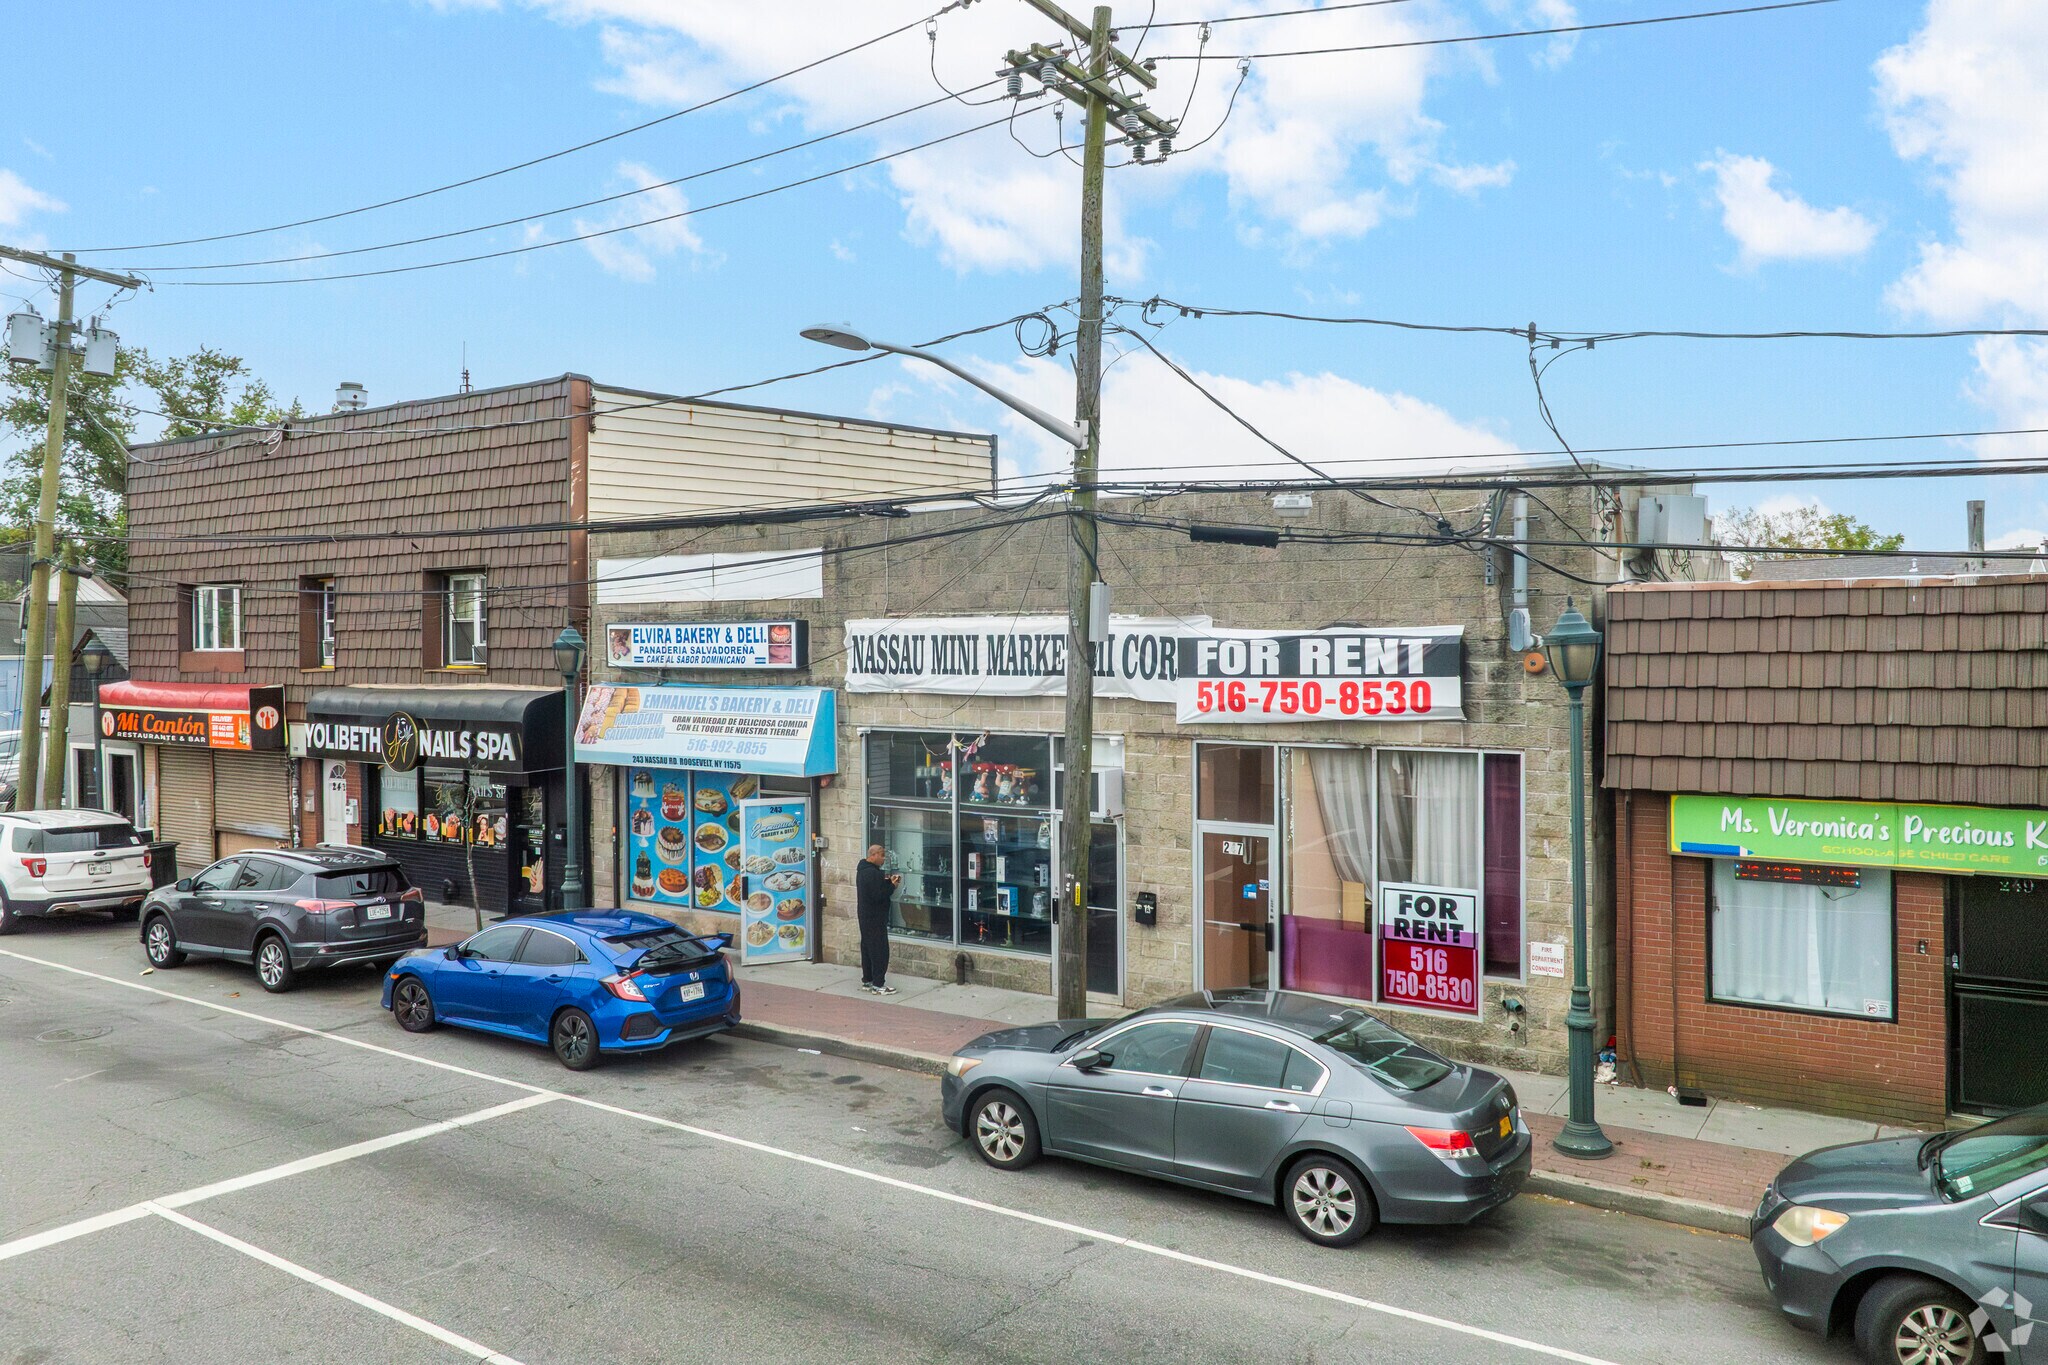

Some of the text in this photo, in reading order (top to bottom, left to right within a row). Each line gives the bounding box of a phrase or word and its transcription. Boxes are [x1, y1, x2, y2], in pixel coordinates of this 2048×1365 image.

[633, 628, 673, 644] ELVIRA
[676, 627, 720, 644] BAKERY
[725, 628, 733, 643] &
[639, 644, 755, 655] PANADERIA SALVADOREÑA
[852, 633, 925, 676] NASSAU
[931, 634, 979, 676] MINI
[986, 633, 1068, 677] MARKE
[1197, 637, 1432, 676] FOR RENT
[646, 656, 746, 664] CAKE AL SABOR DOMINICANO
[643, 693, 815, 715] EMMANUEL'S BAKERY & DELI
[1197, 680, 1432, 715] 516-750-8530
[117, 712, 139, 732] Mi
[614, 713, 664, 726] PANADERIA
[672, 716, 808, 728] GRAN VARIEDAD DE DELICIOSA COMIDA
[117, 731, 177, 742] RESTAURANTE
[676, 724, 799, 736] CON EL TOQUE DE NUESTRA TIERRA!
[305, 723, 381, 753] YOLIBETH
[419, 729, 471, 759] NAILS
[476, 731, 516, 761] SPA
[687, 738, 768, 755] 516-992-8855
[632, 755, 644, 764] 243
[645, 756, 668, 765] NASSAU
[715, 759, 722, 768] NY
[724, 760, 741, 769] 11575
[770, 806, 783, 814] 243
[1721, 806, 1758, 834] Ms.
[1768, 807, 1890, 841] Veronica's
[1904, 815, 2015, 848] Precious
[1920, 850, 1965, 861] CHILD
[1969, 854, 2011, 864] CARE
[1398, 893, 1459, 920] FOR
[1394, 917, 1464, 943] RENT
[1410, 946, 1448, 974] 516
[1532, 955, 1563, 965] DEPARTMENT
[1532, 965, 1563, 974] CONNECTION
[1387, 969, 1472, 1004] 750-8530
